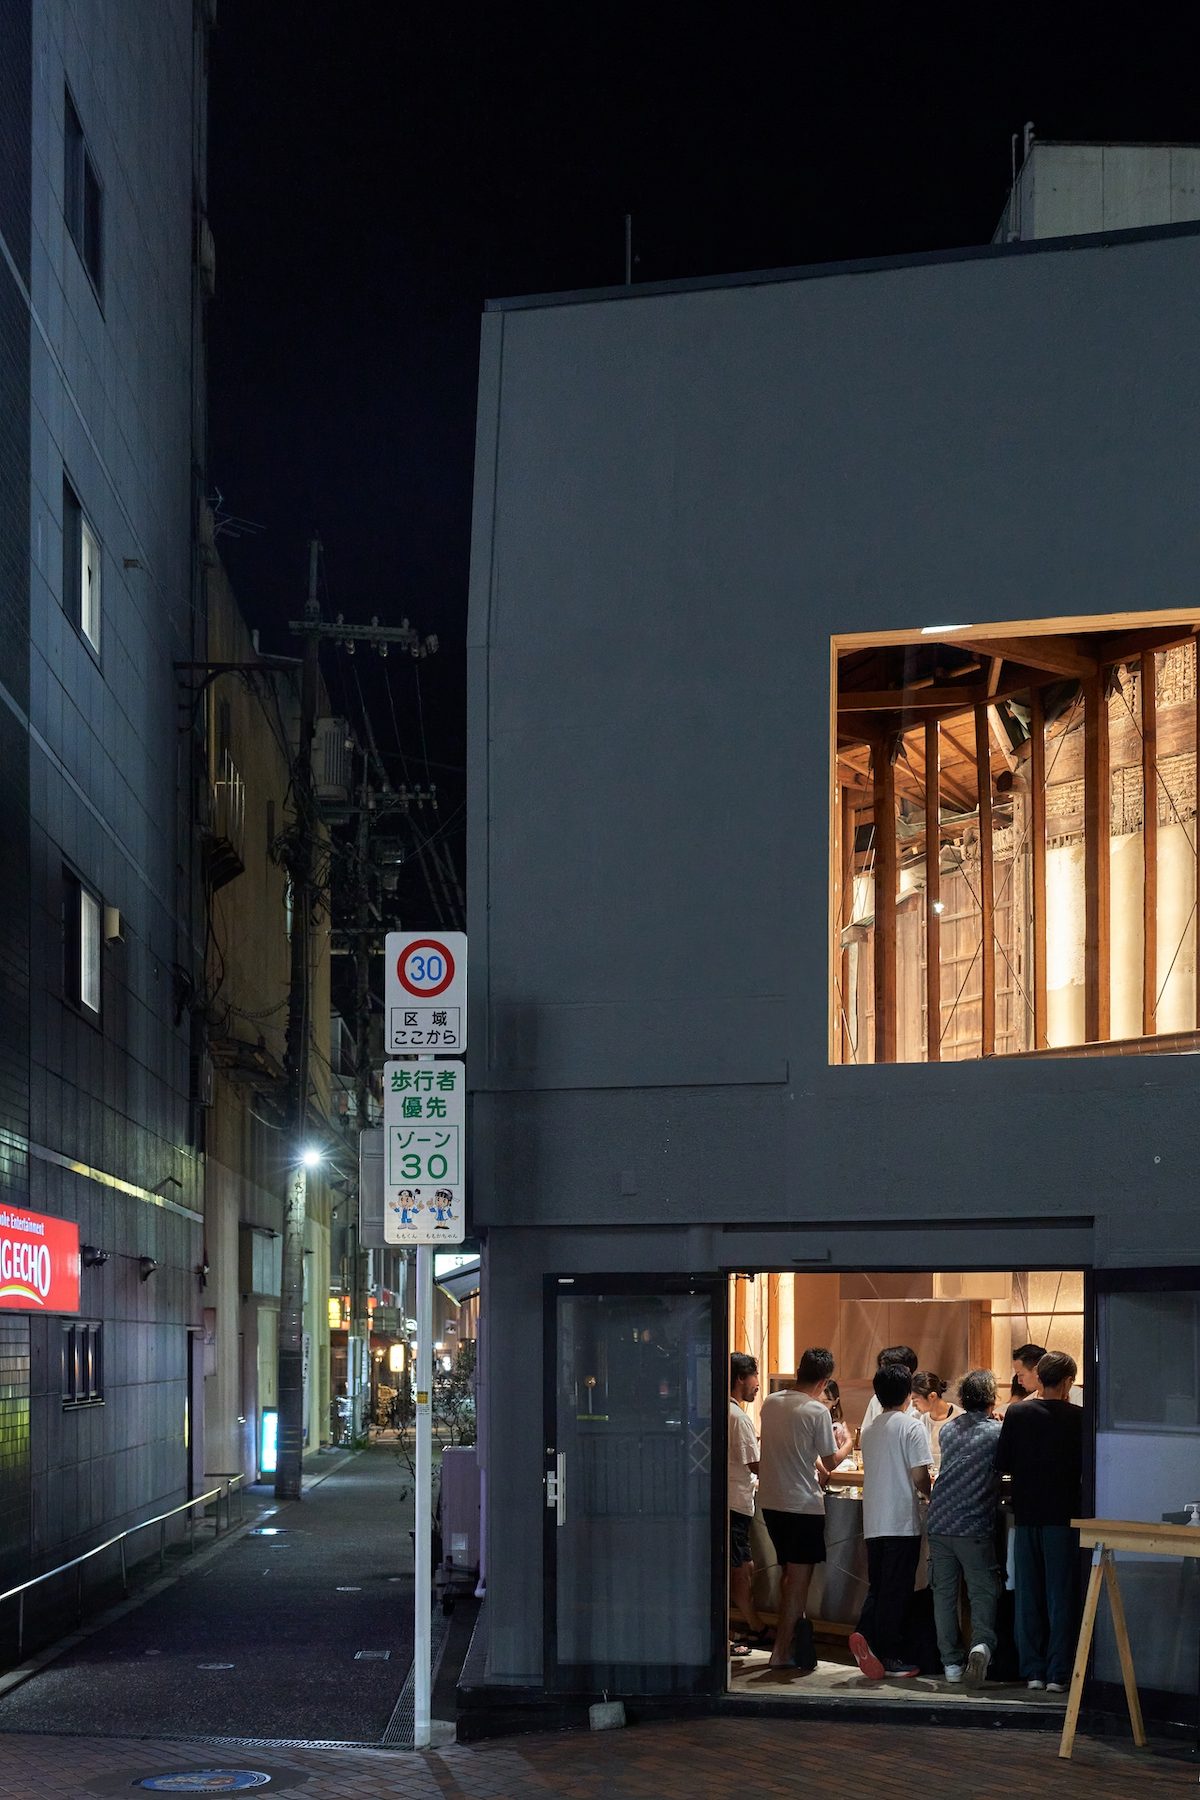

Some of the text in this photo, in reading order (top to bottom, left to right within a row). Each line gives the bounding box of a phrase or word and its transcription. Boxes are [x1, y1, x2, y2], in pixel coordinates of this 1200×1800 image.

[410, 955, 443, 981] 30
[394, 1030, 456, 1044] ここから
[391, 1070, 457, 1092] 歩行者
[401, 1096, 447, 1119] 優先
[397, 1131, 451, 1149] ゾーン
[401, 1153, 448, 1179] 30
[10, 1213, 45, 1236] Entertainment
